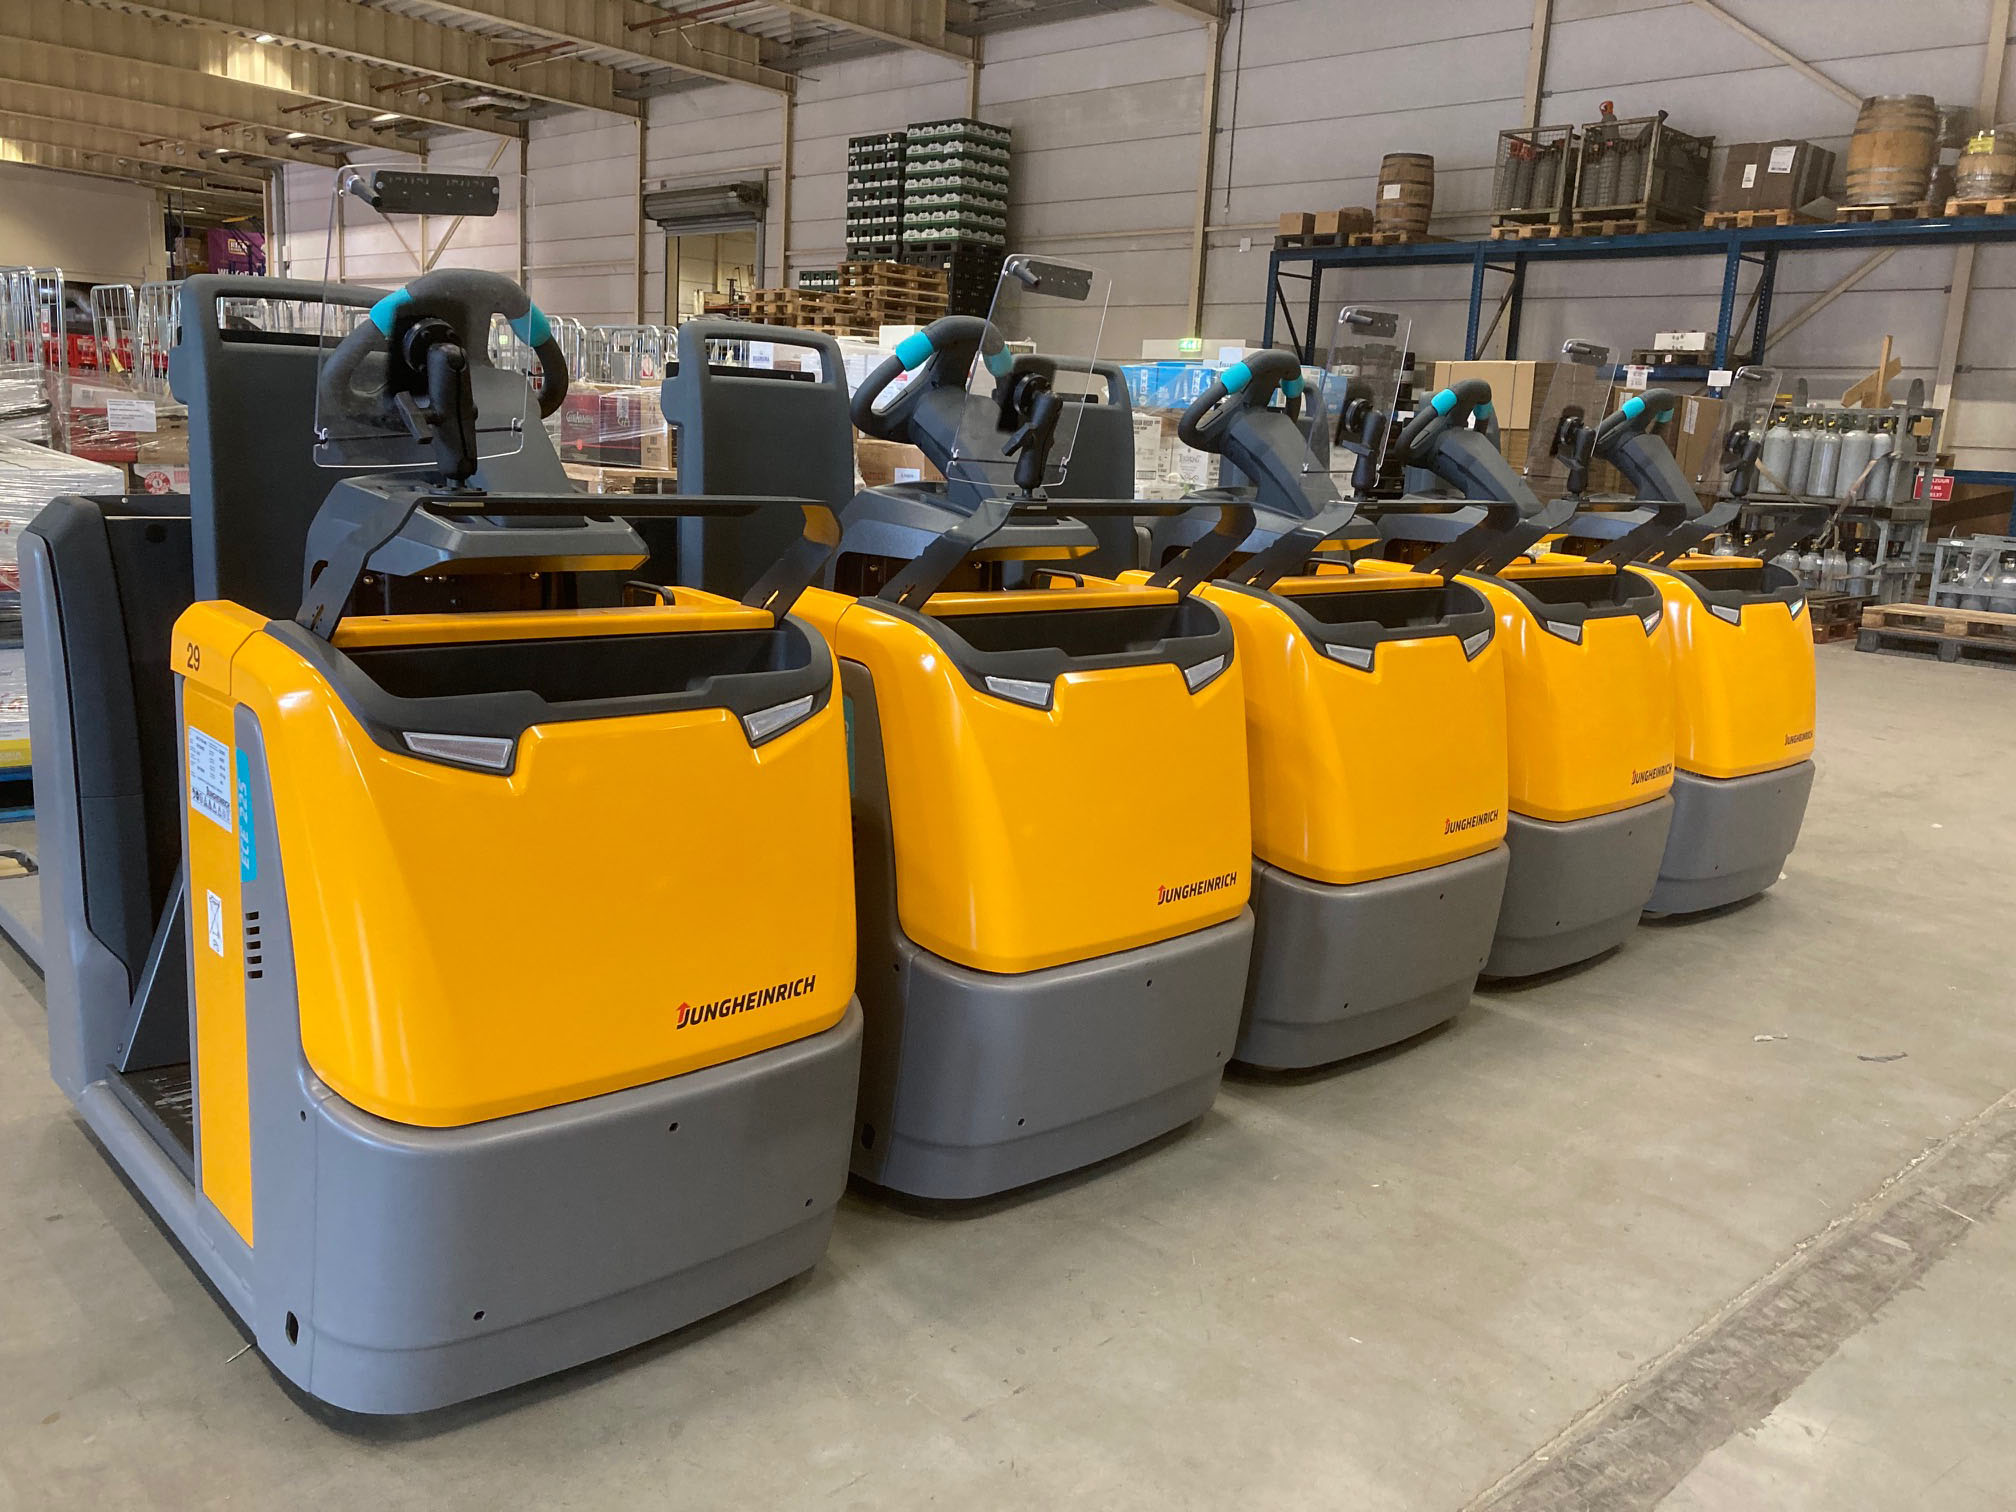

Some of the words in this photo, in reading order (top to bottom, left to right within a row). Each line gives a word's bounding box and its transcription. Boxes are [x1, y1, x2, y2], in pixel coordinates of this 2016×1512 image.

[187, 642, 200, 672] 29
[1631, 763, 1673, 786] JUNGHEINRICH
[238, 780, 249, 825] 225
[1444, 808, 1499, 835] JUNGHEINRICH
[240, 825, 250, 871] ECE
[1157, 871, 1237, 906] JUNGHEINRICH
[675, 974, 816, 1031] JUNGHEINRICH
